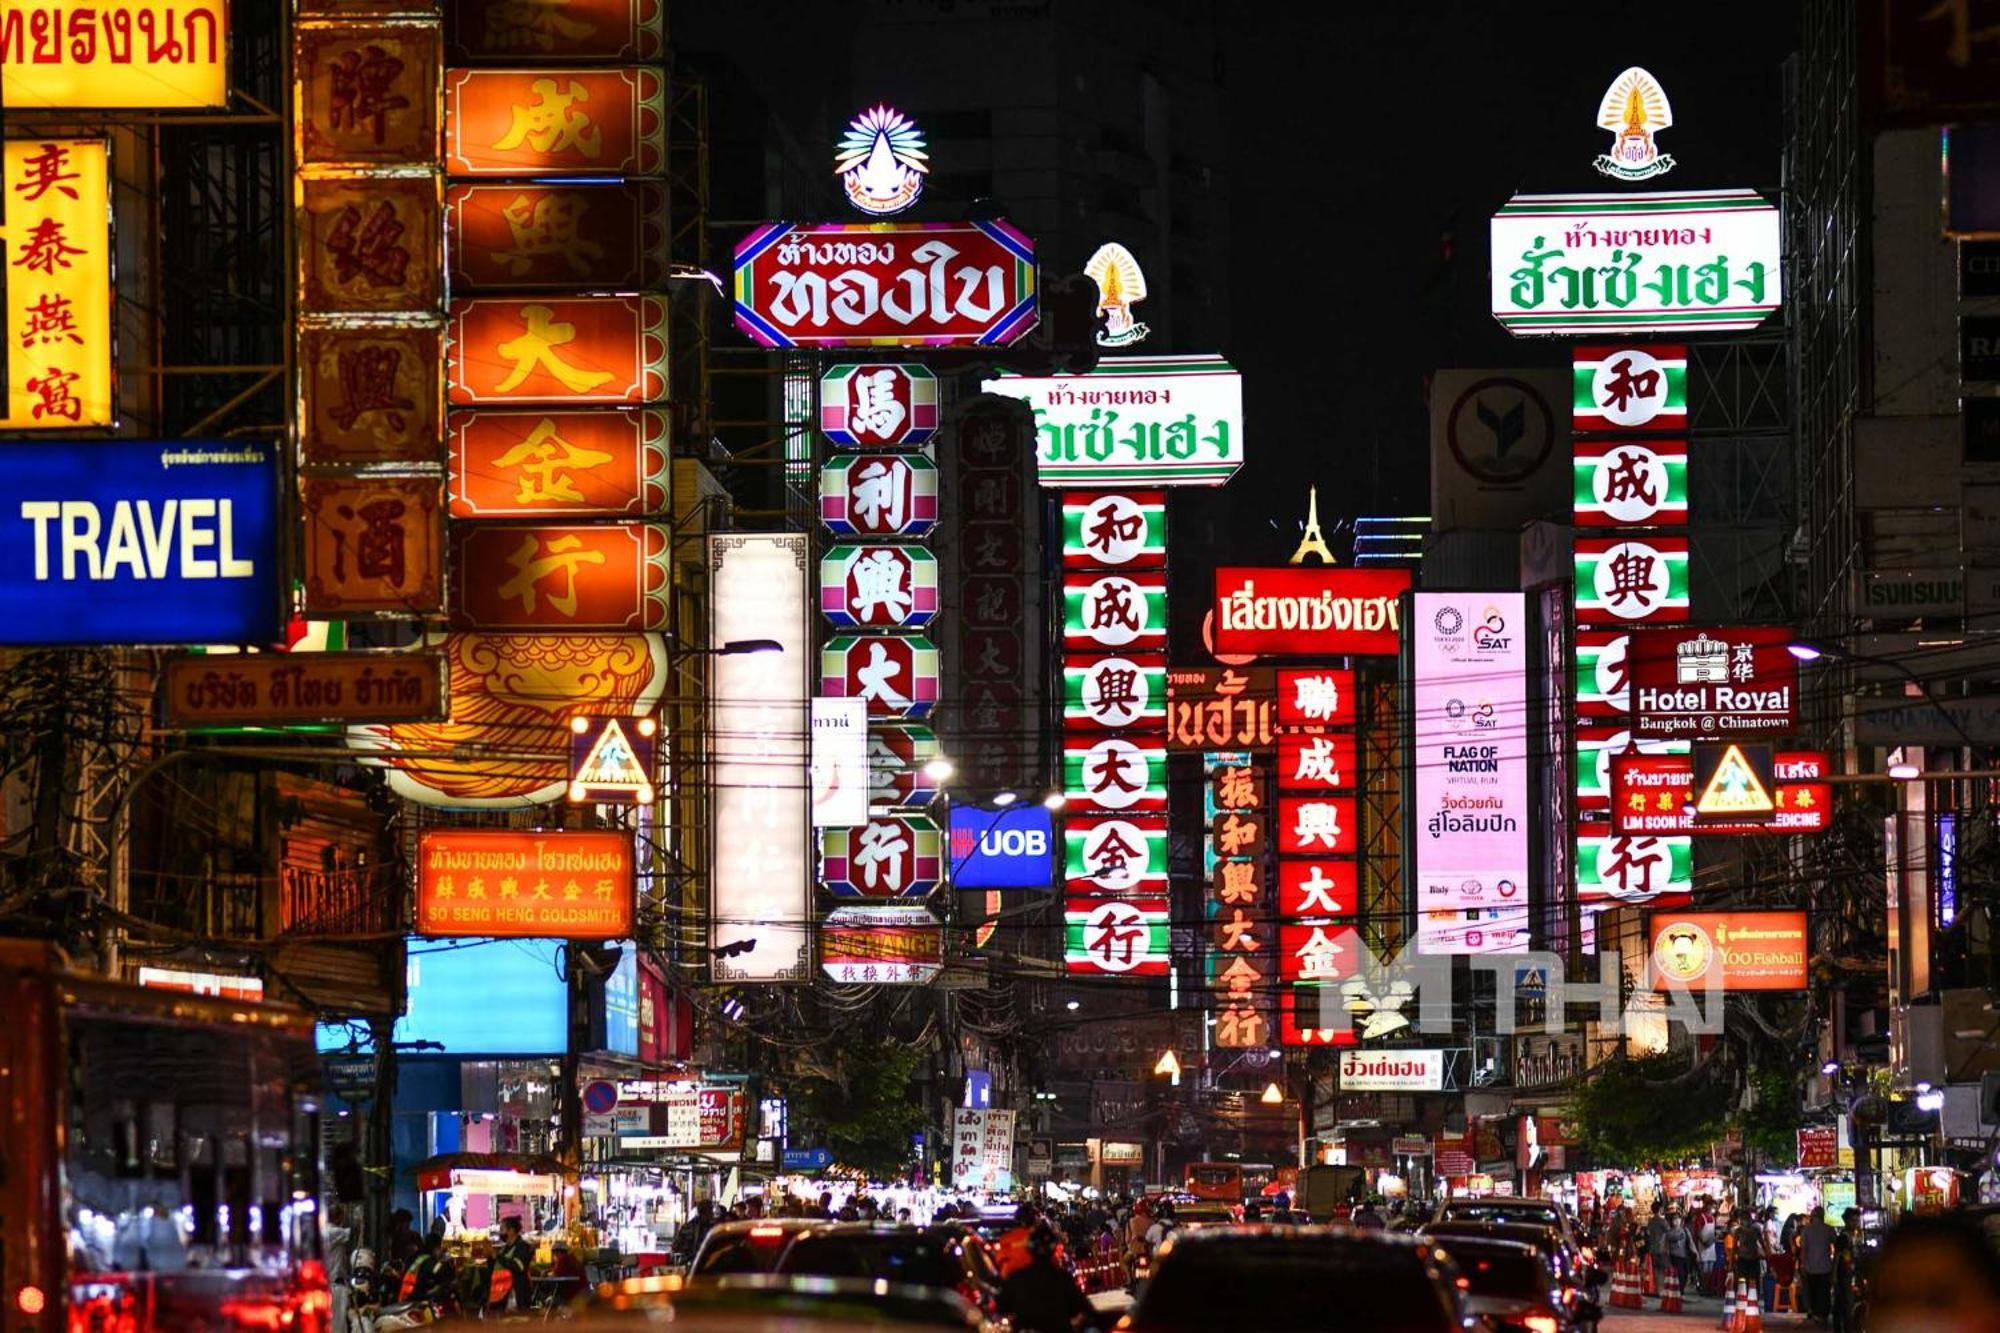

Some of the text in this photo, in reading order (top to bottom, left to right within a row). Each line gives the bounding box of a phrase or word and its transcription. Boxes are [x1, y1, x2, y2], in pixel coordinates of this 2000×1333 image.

[1565, 222, 1711, 247] ห้างขายทอง
[777, 234, 895, 266] ห้างทอง
[1510, 235, 1765, 309] ฮั่วเซ่งเฮง
[1048, 384, 1171, 405] ห้างขายทอง
[21, 499, 254, 580] TRAVEL
[1602, 358, 1662, 892] 和成興行
[1478, 637, 1512, 649] SAT
[1639, 686, 1789, 713] Hotel Royal
[1640, 715, 1789, 732] Bangkok @ Chinatown
[1444, 746, 1498, 759] FLAG OF
[1450, 760, 1498, 772] NATION
[1428, 811, 1516, 838] สู่โอลิมปิก
[1624, 817, 1642, 829] LIM
[1645, 816, 1677, 829] SOON
[1766, 813, 1820, 827] EDICINE
[980, 829, 1047, 857] UOB
[430, 846, 525, 870] ห้างขายทอง
[1294, 675, 1344, 1041] 聯成興大金
[429, 907, 621, 922] SO SENG HENG GOLDSMITH
[1754, 952, 1803, 965] Fishball
